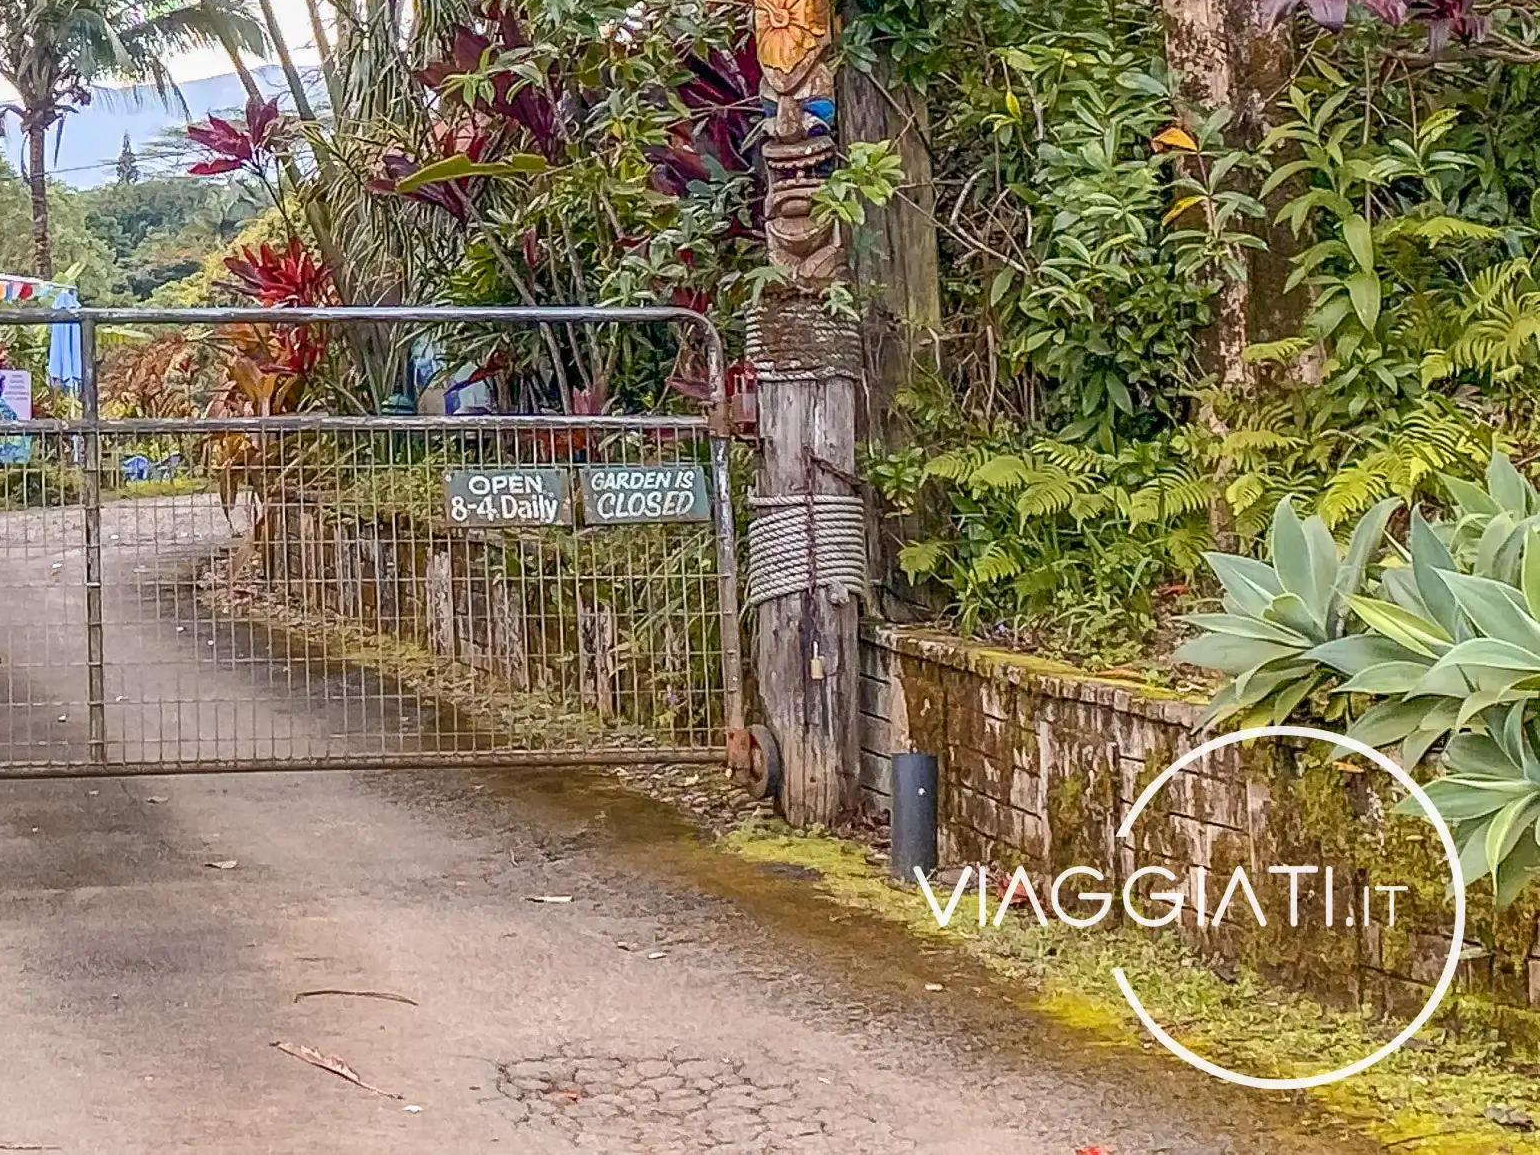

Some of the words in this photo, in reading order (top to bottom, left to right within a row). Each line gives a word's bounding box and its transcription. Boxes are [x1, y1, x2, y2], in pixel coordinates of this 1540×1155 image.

[468, 474, 543, 495] OPEN
[591, 471, 672, 491] GARDEN
[674, 470, 695, 489] IS
[500, 494, 558, 524] Daily
[596, 490, 695, 519] CLOSED
